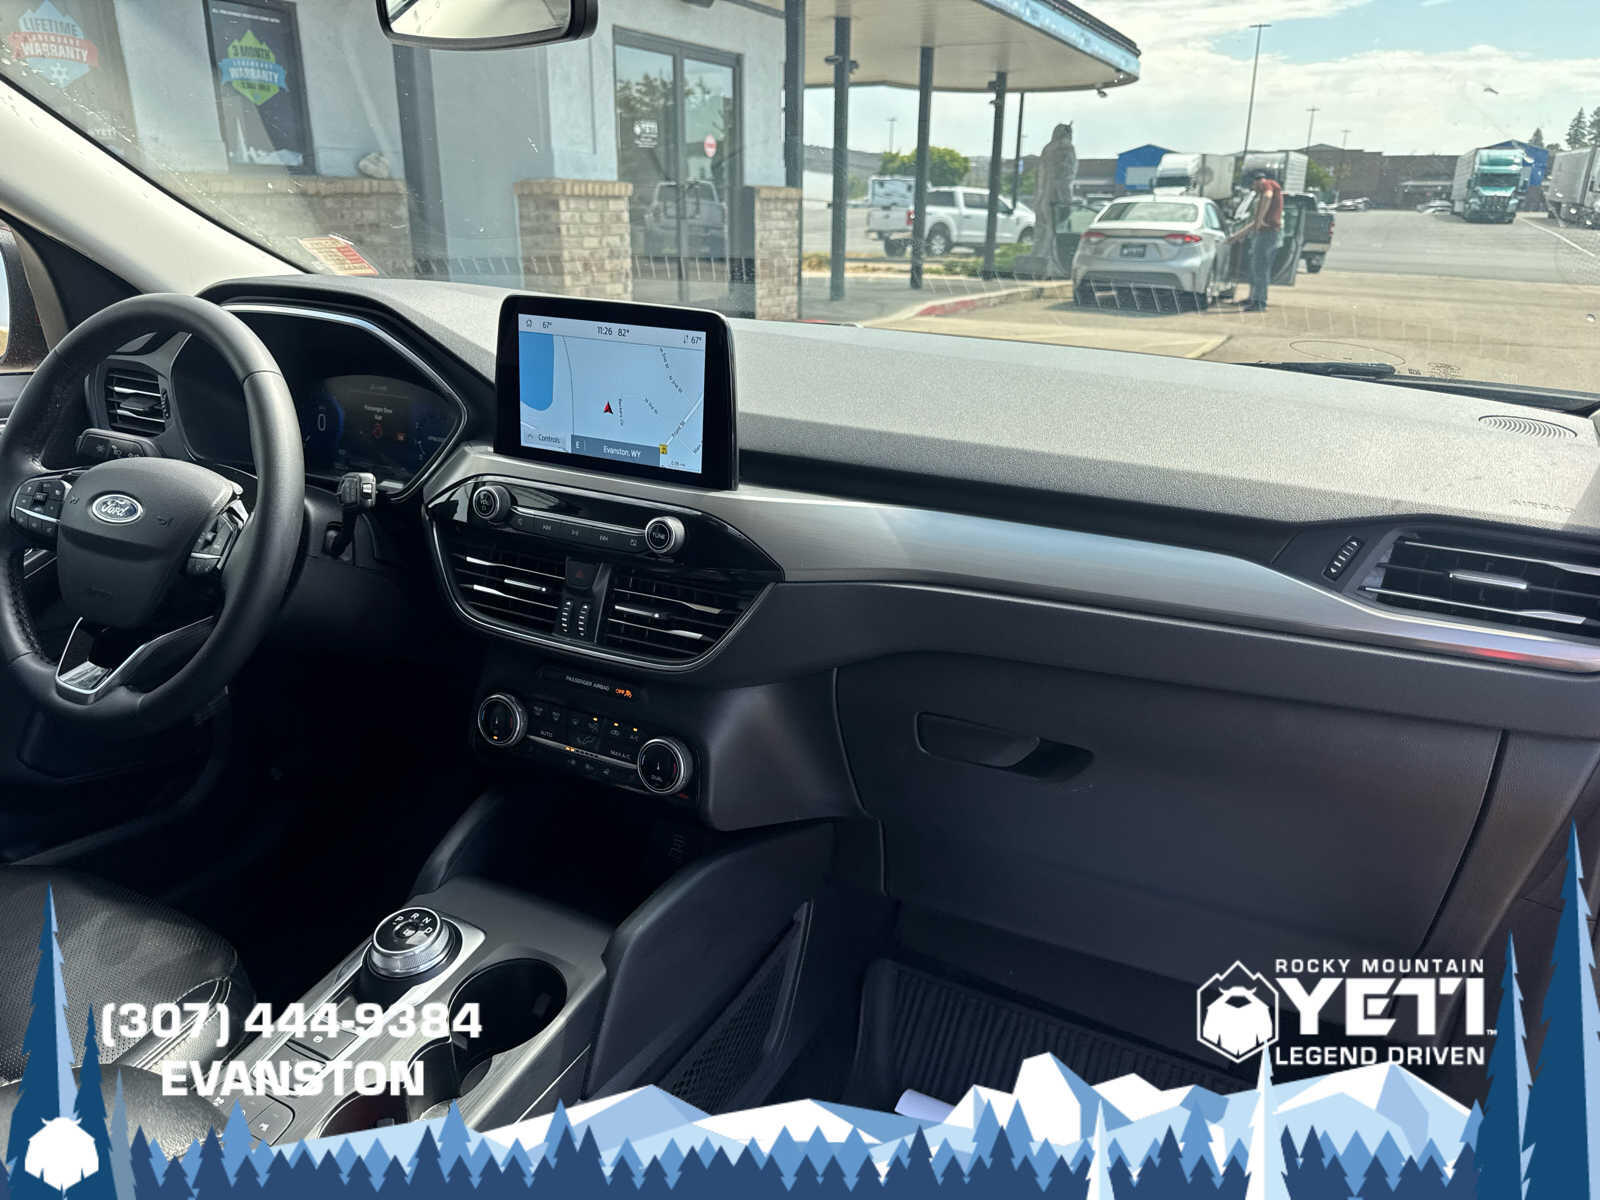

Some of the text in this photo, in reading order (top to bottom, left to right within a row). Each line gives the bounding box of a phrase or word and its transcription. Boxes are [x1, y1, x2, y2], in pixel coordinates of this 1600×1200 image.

[22, 17, 83, 38] LIFETIME
[20, 41, 88, 63] WARRANTY
[232, 45, 239, 57] 3
[229, 67, 279, 83] WARRANTY
[597, 326, 612, 336] 11:26
[317, 413, 326, 432] 0
[538, 433, 561, 444] Controls
[629, 448, 641, 458] WY
[101, 498, 128, 517] Ford
[540, 730, 553, 738] AUTO
[410, 912, 420, 920] R
[424, 926, 433, 934] D
